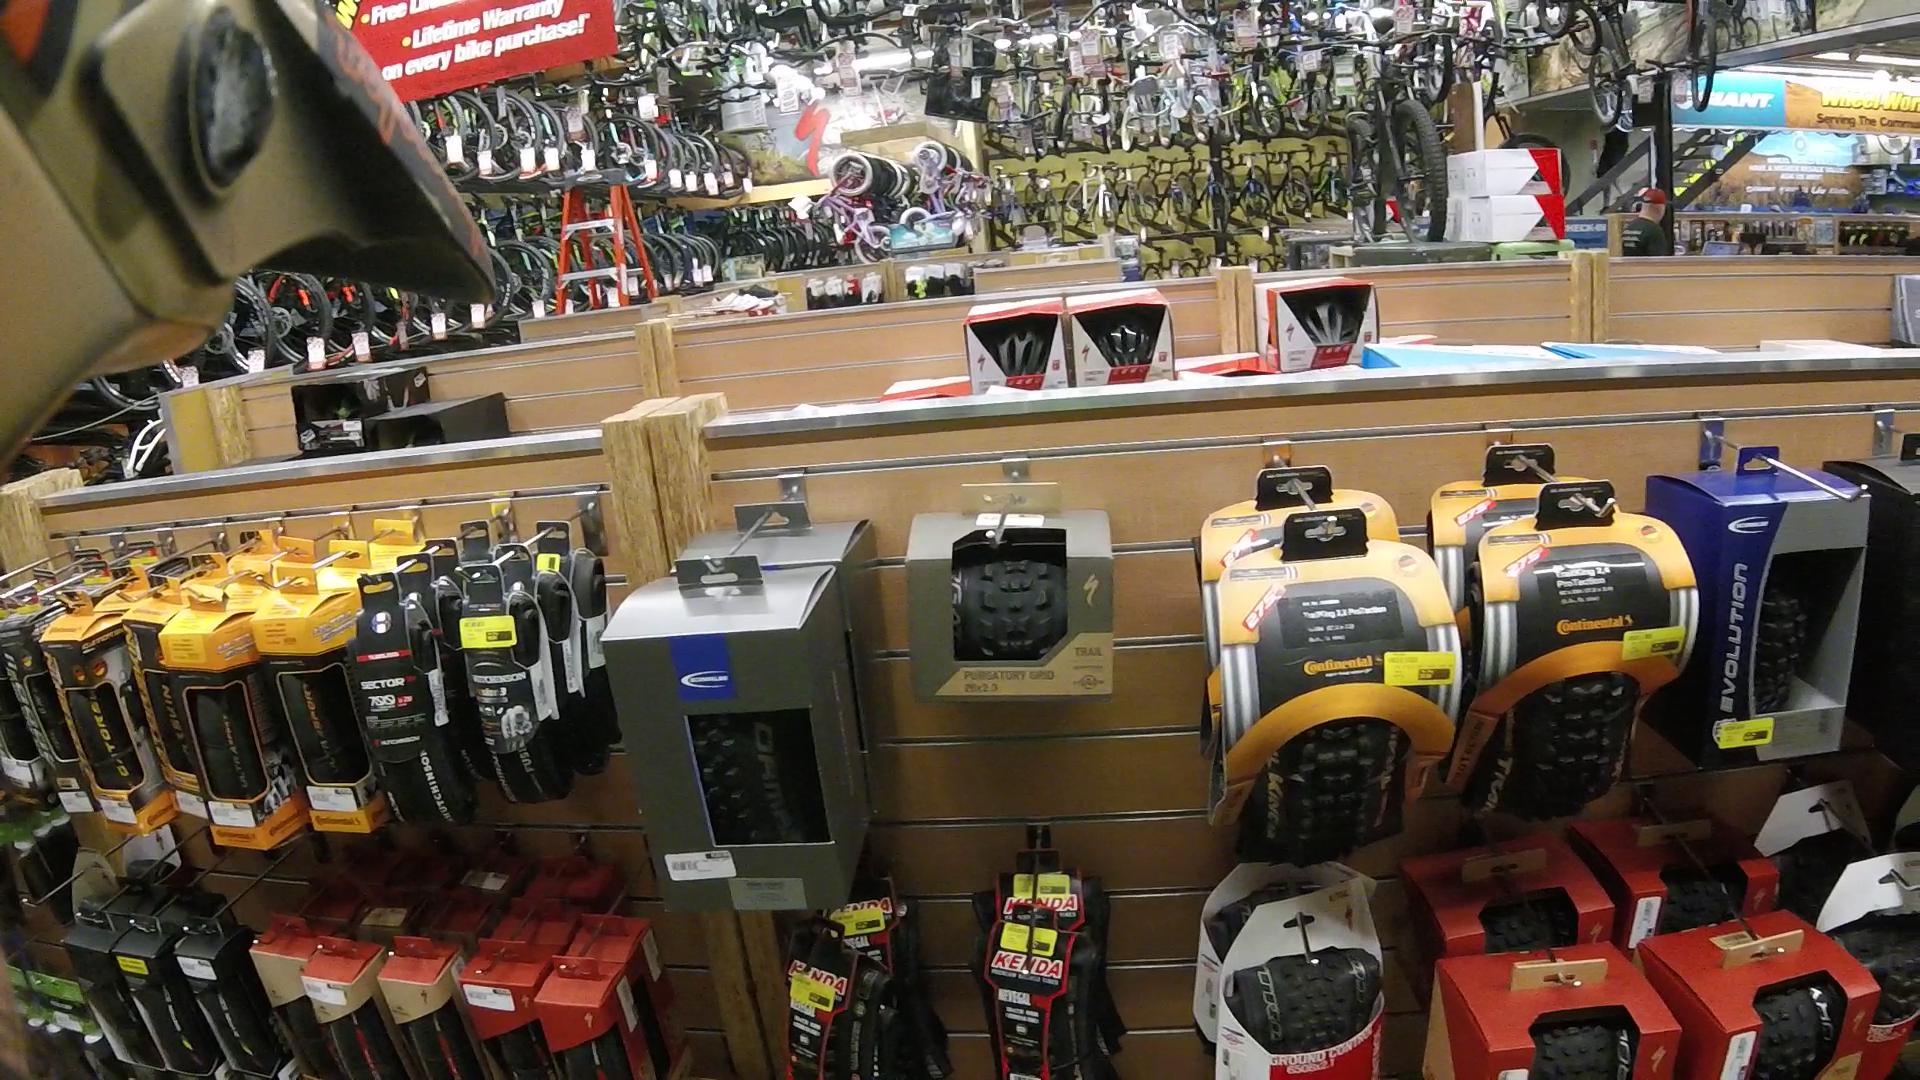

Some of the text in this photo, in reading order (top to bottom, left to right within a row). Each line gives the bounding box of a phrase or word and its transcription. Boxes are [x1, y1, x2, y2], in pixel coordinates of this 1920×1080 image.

[370, 2, 406, 26] Free
[412, 17, 481, 49] Lifetime
[482, 0, 566, 31] Warranty
[382, 63, 403, 81] on
[405, 50, 452, 75] every
[454, 40, 492, 64] bike
[1816, 113, 1857, 128] Serving
[1859, 114, 1877, 126] The
[1556, 616, 1624, 635] Continental
[1720, 562, 1749, 713] EVOLUTION
[1304, 655, 1374, 676] Continental
[361, 677, 405, 690] SECTOR
